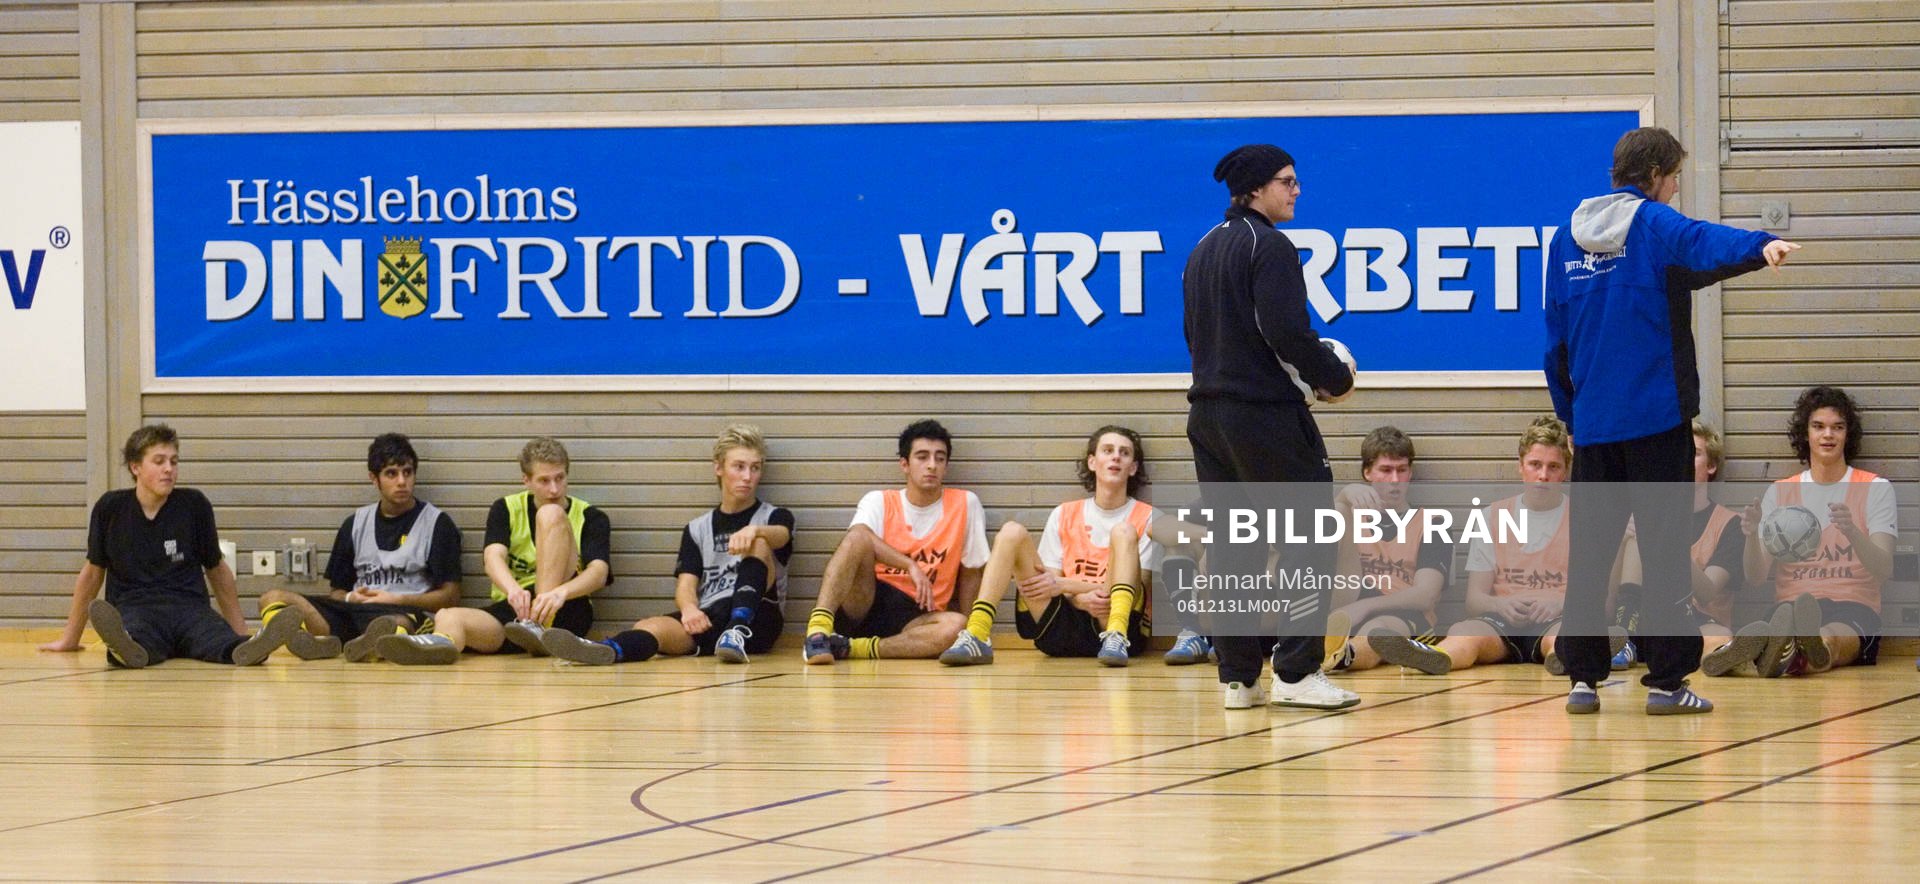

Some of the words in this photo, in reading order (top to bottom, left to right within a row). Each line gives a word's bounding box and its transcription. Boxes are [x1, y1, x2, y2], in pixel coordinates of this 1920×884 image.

[228, 174, 578, 225] Hässleholms
[202, 239, 364, 321] DIN
[430, 235, 802, 320] FRITID
[898, 208, 1165, 327] VÅRT
[1277, 226, 1559, 324] RBET
